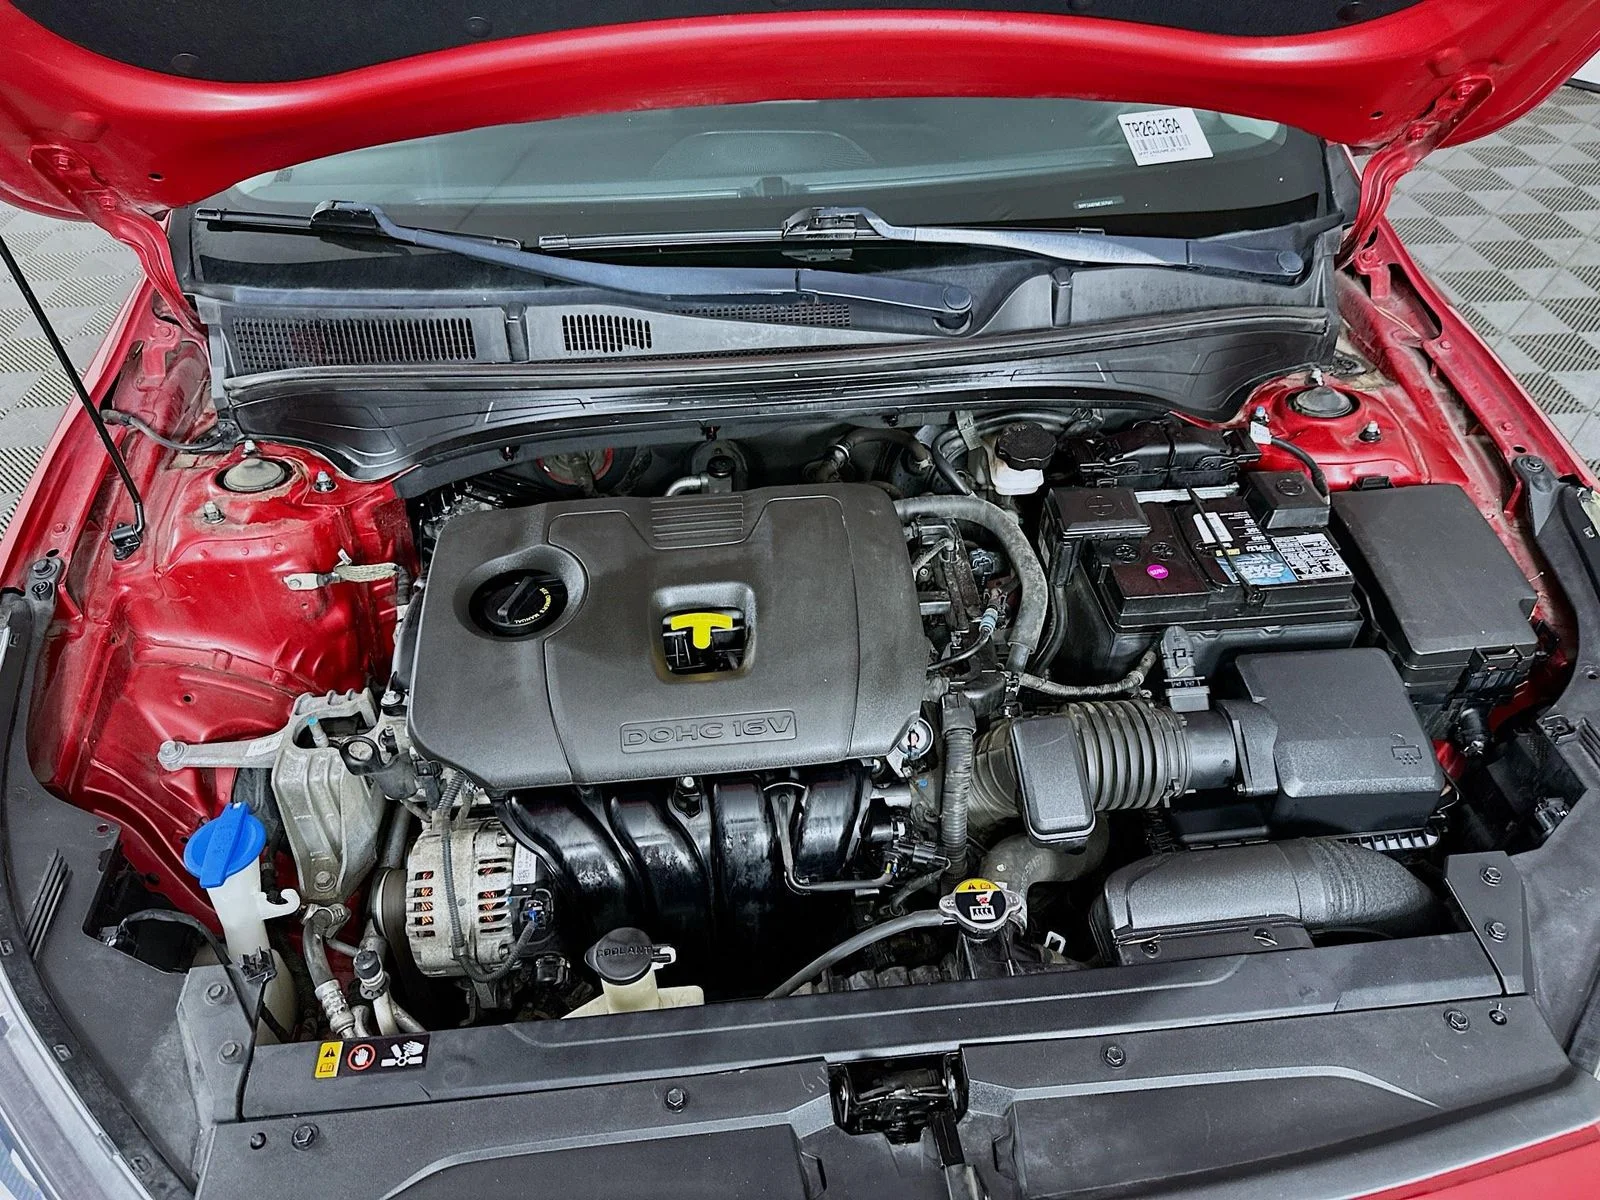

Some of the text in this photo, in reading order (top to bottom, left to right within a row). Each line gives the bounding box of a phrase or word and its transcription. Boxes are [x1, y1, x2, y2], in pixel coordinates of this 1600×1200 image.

[1125, 118, 1183, 138] TR26136A
[514, 613, 540, 624] MANUAL
[623, 716, 792, 746] DOHC 16V
[596, 945, 653, 957] COOLANT
